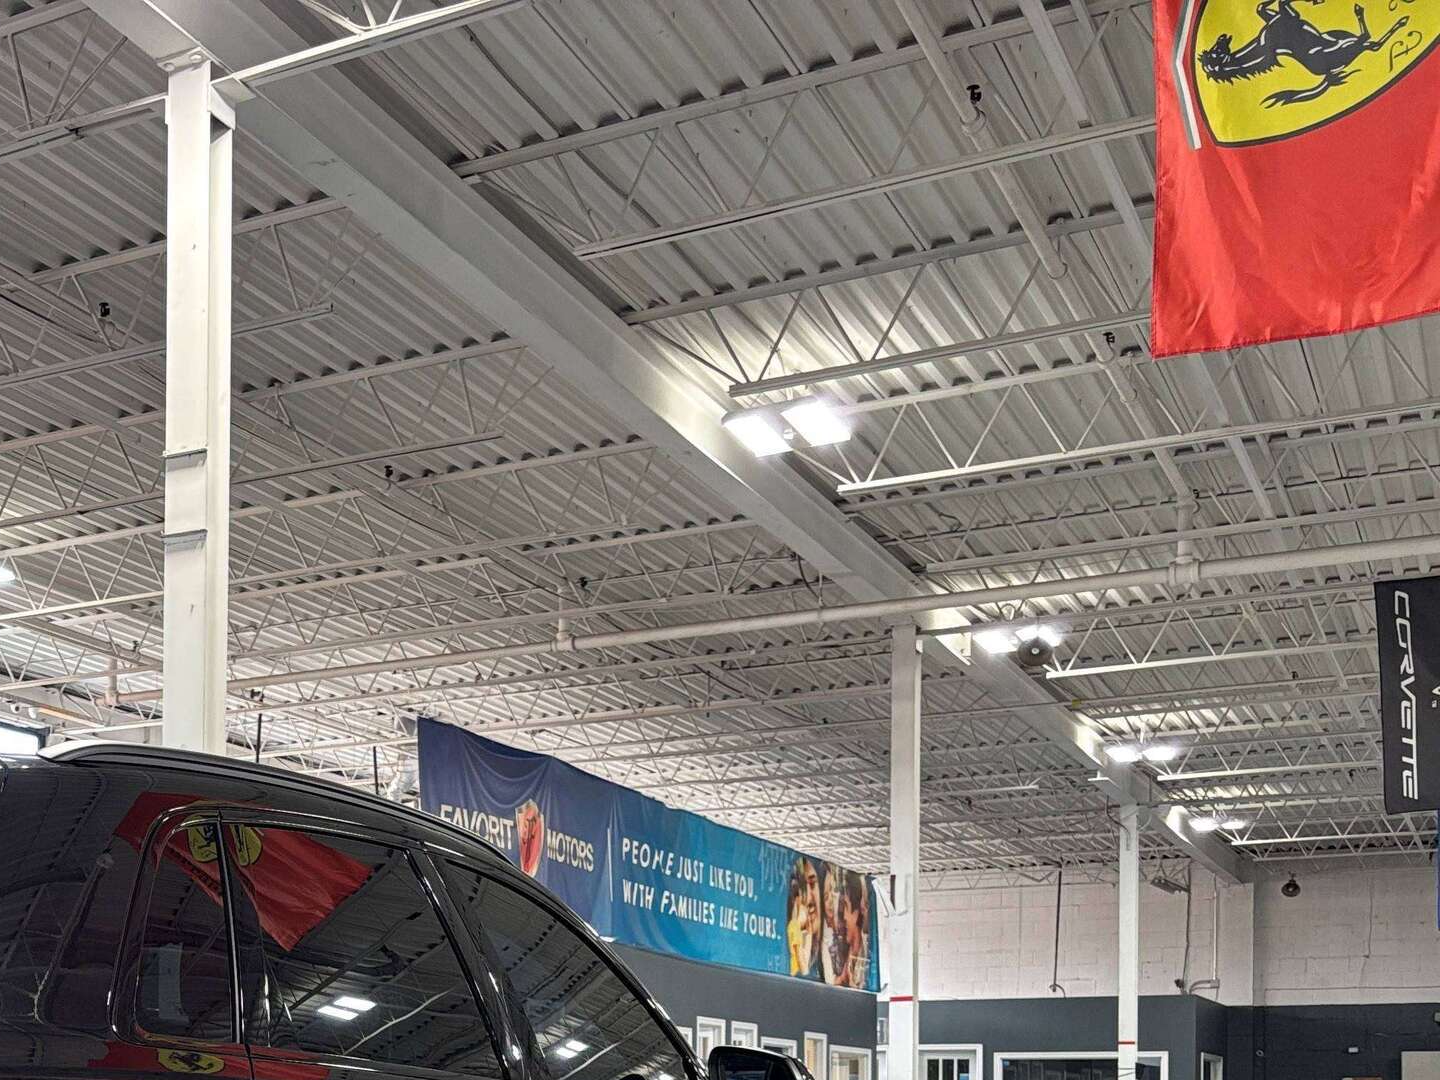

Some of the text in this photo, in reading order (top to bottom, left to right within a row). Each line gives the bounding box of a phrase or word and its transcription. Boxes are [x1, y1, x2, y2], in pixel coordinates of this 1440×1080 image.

[1394, 590, 1418, 801] CORVETTE
[440, 804, 514, 850] FAVORIT
[546, 829, 594, 872] MOTORS
[622, 879, 782, 940] WITH FAMILIES LIKE YOURS.
[677, 856, 705, 885] JUST
[709, 864, 732, 892] LIKE
[733, 873, 758, 902] YOU,
